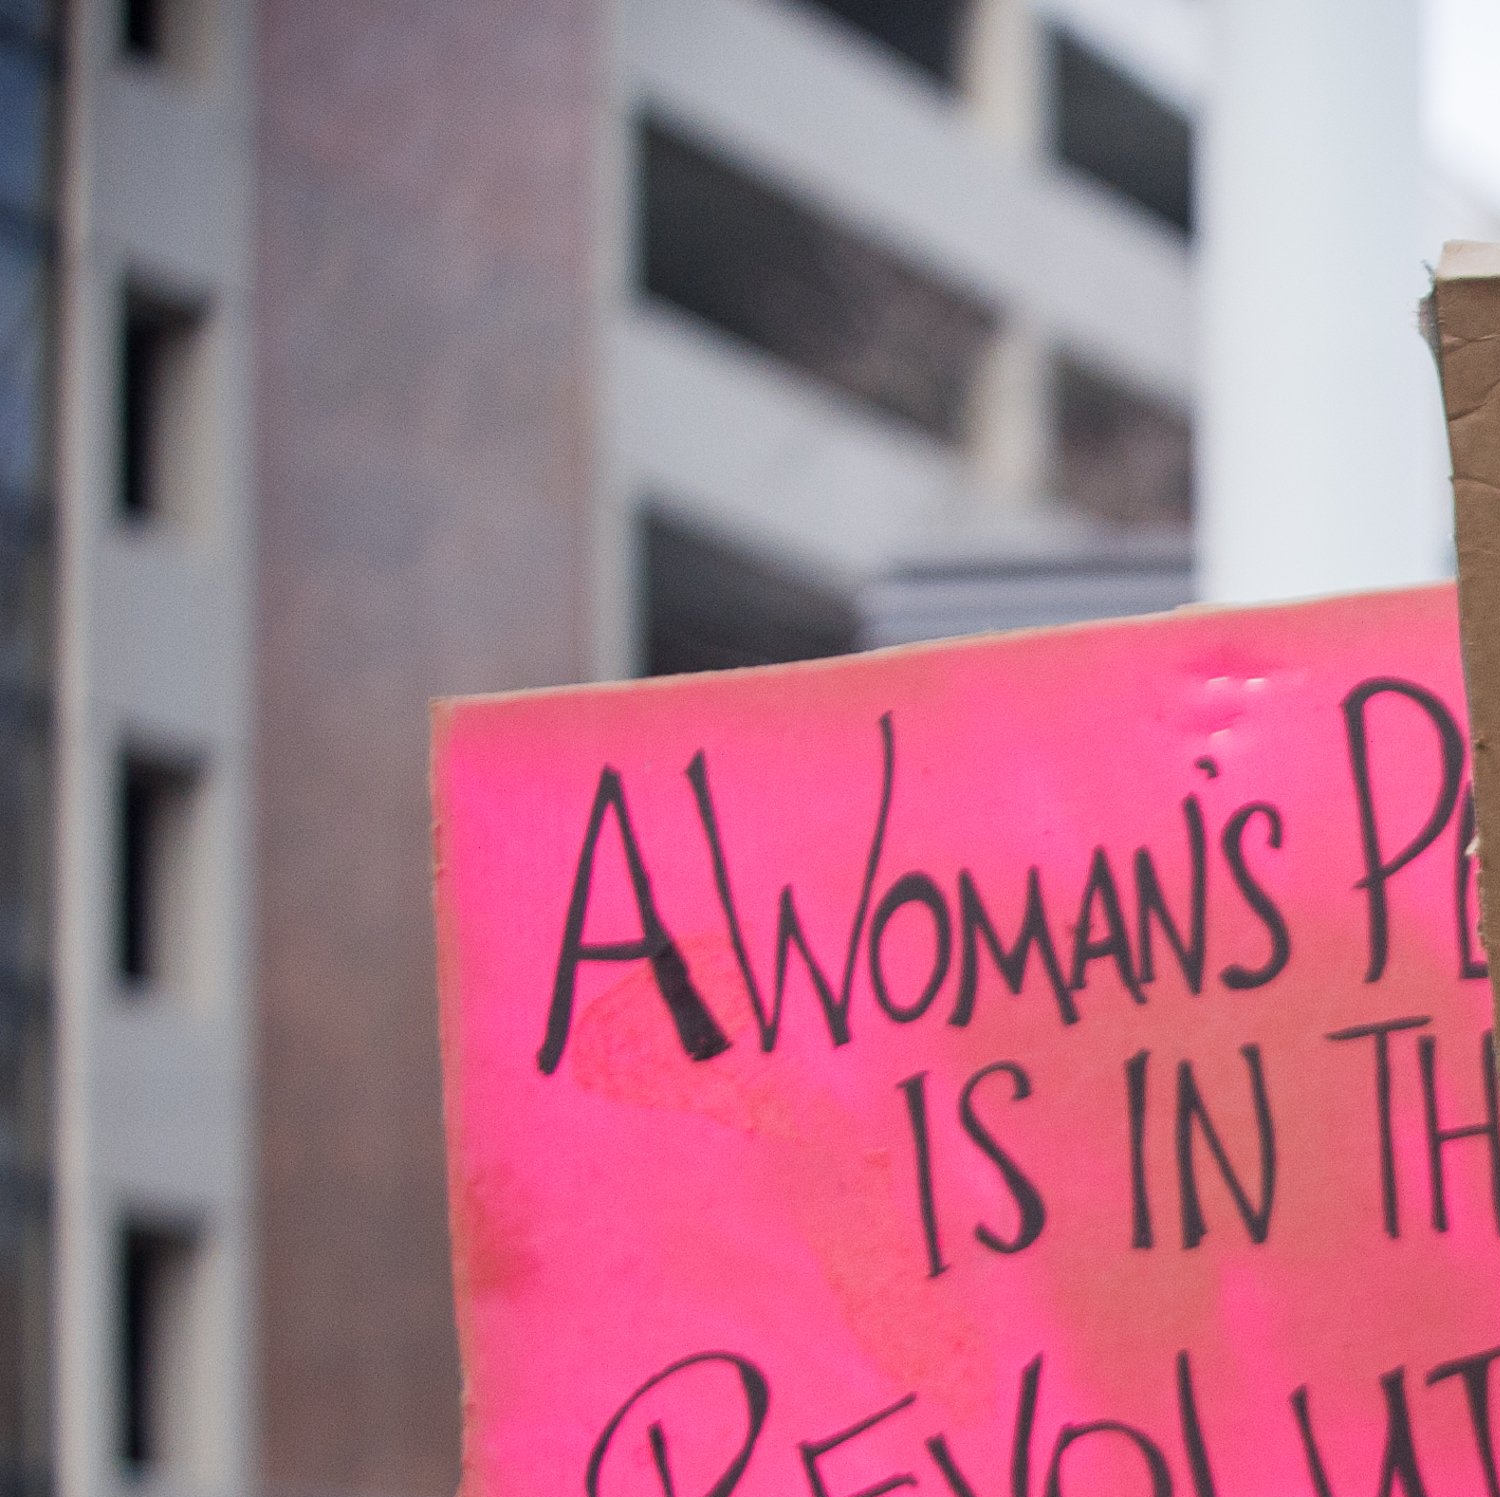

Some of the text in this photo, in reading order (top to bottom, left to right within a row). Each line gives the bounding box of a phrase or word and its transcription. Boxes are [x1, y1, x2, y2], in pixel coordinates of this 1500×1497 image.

[536, 764, 734, 1076] A
[895, 1055, 1049, 1278] IS
[1124, 1042, 1278, 1252] IN
